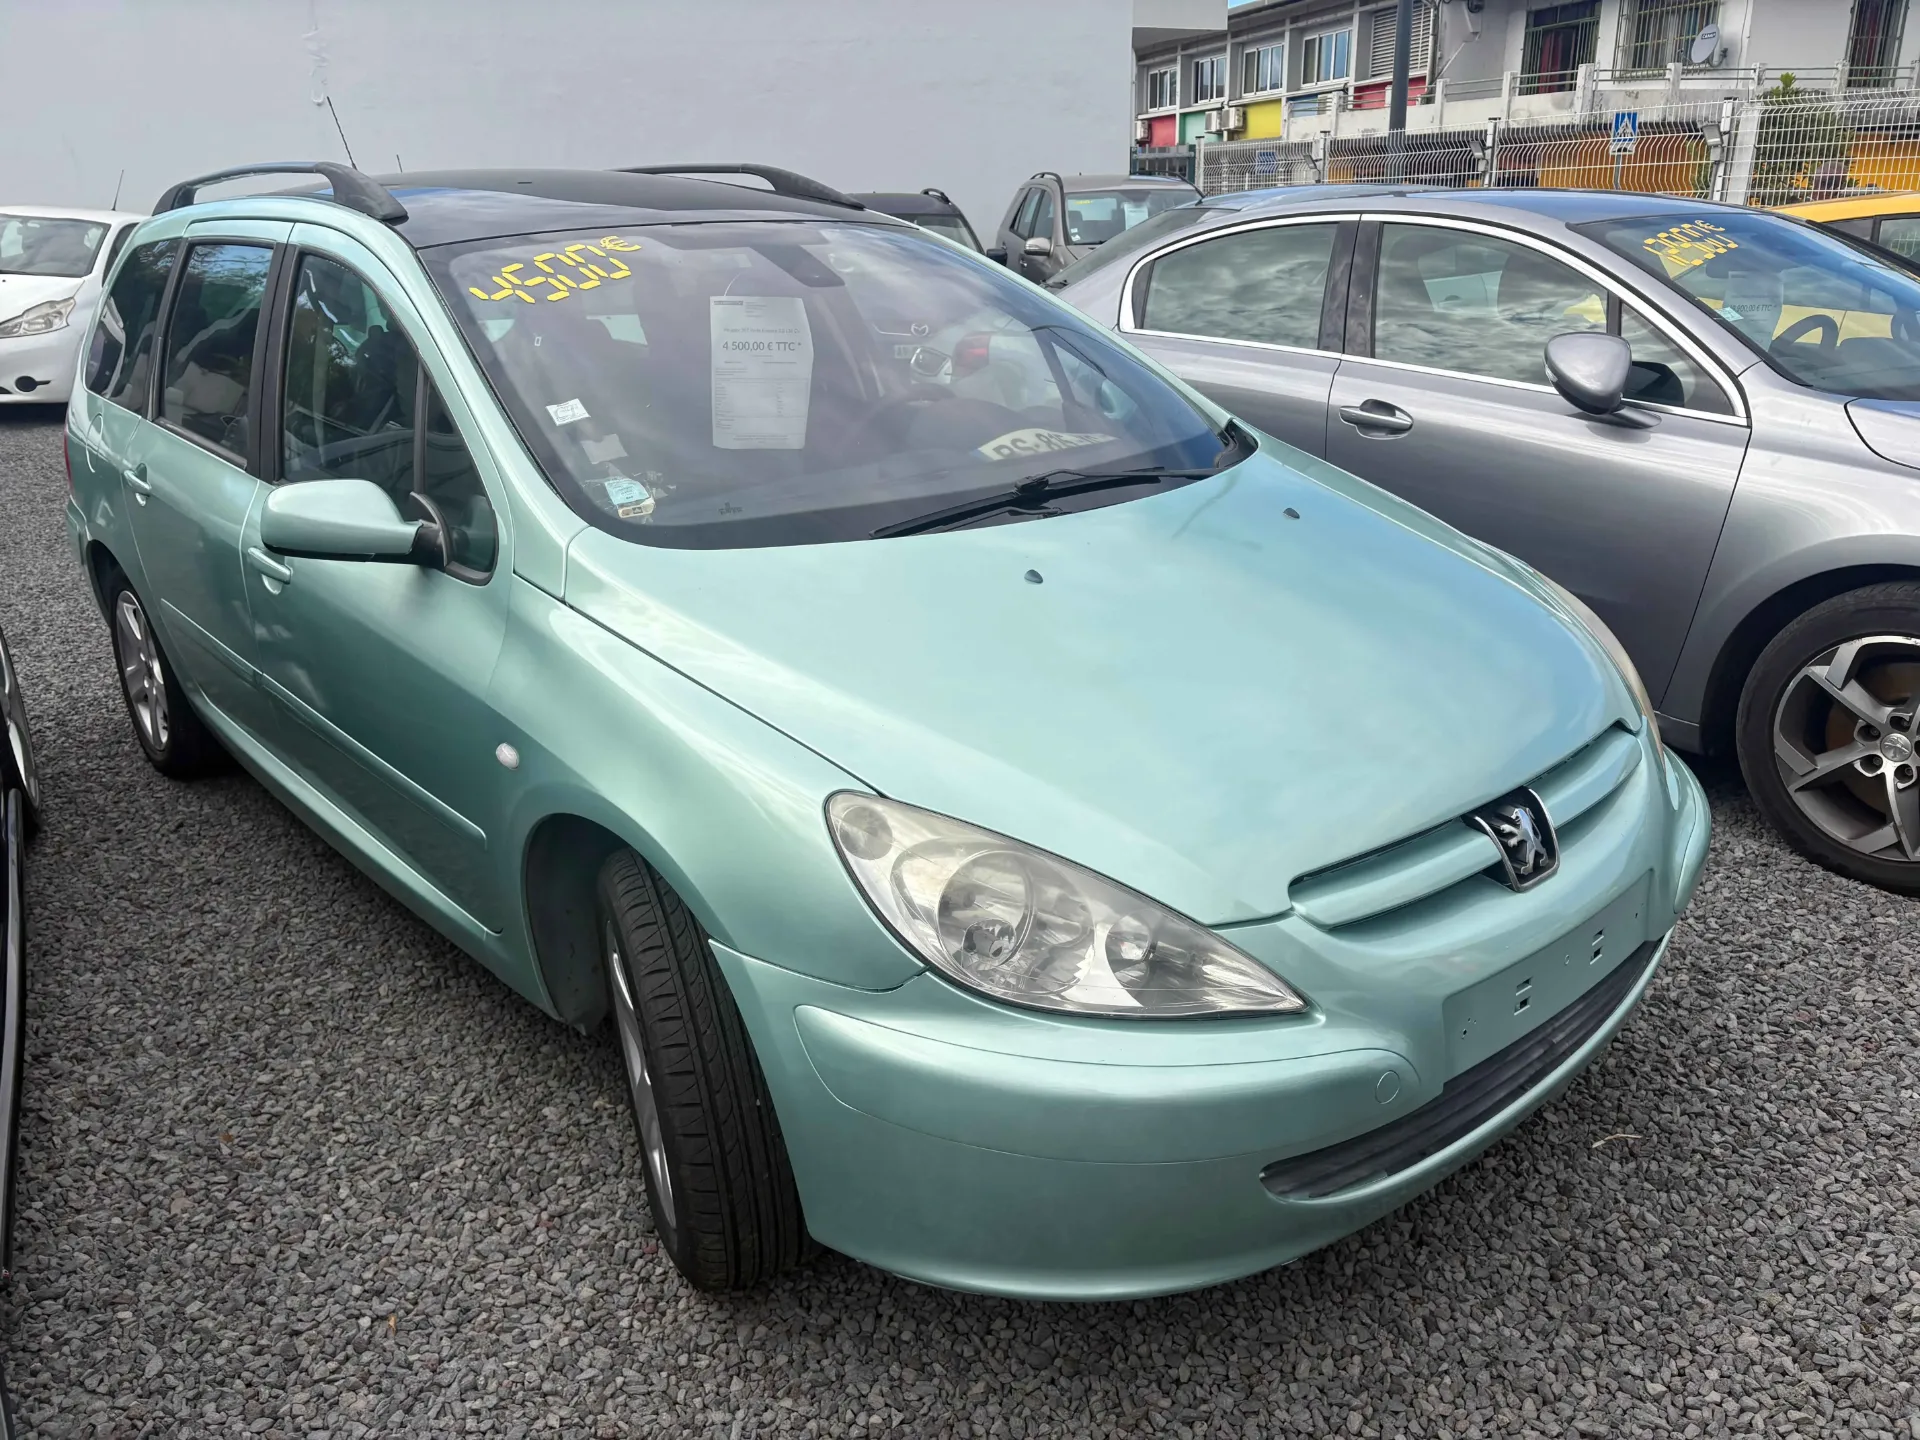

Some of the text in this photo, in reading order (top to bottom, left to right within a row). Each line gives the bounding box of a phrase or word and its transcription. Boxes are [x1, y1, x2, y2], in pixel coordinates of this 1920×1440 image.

[469, 236, 641, 304] 4500€
[1761, 304, 1772, 312] TTC
[722, 341, 796, 352] 4 500,00 € TTC
